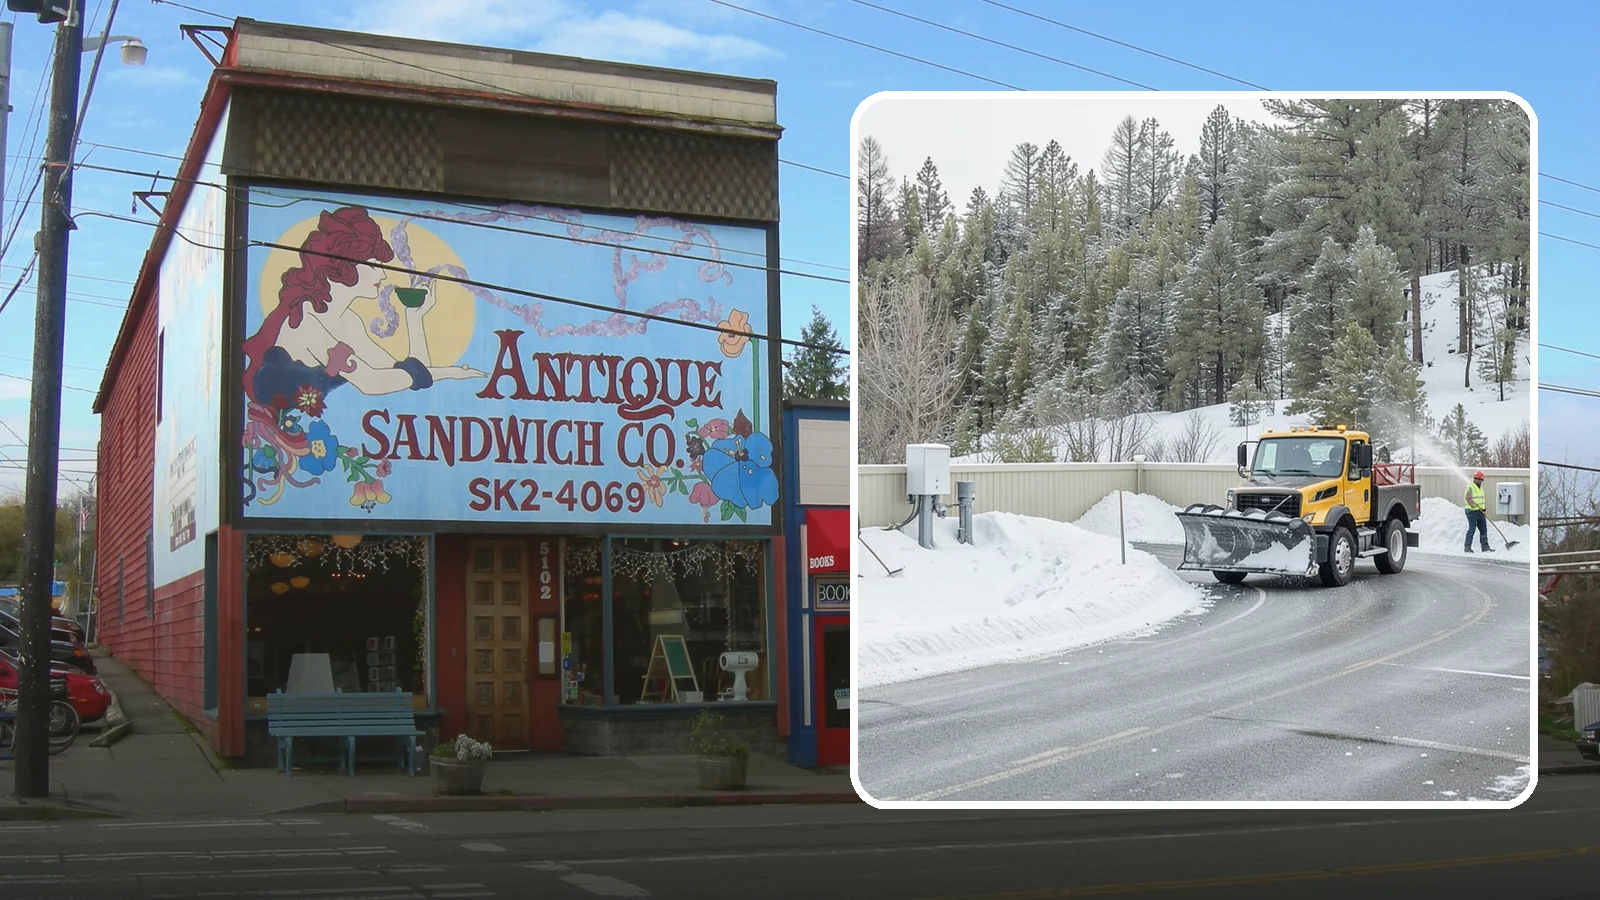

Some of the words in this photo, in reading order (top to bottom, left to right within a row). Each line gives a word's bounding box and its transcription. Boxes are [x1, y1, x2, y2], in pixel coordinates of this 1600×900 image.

[475, 329, 723, 420] ANTIQUE
[361, 408, 604, 467] SANDWICH
[617, 421, 685, 468] CO.
[468, 477, 646, 512] SK2-4069
[539, 541, 552, 600] 5102
[809, 555, 834, 569] BOOKS
